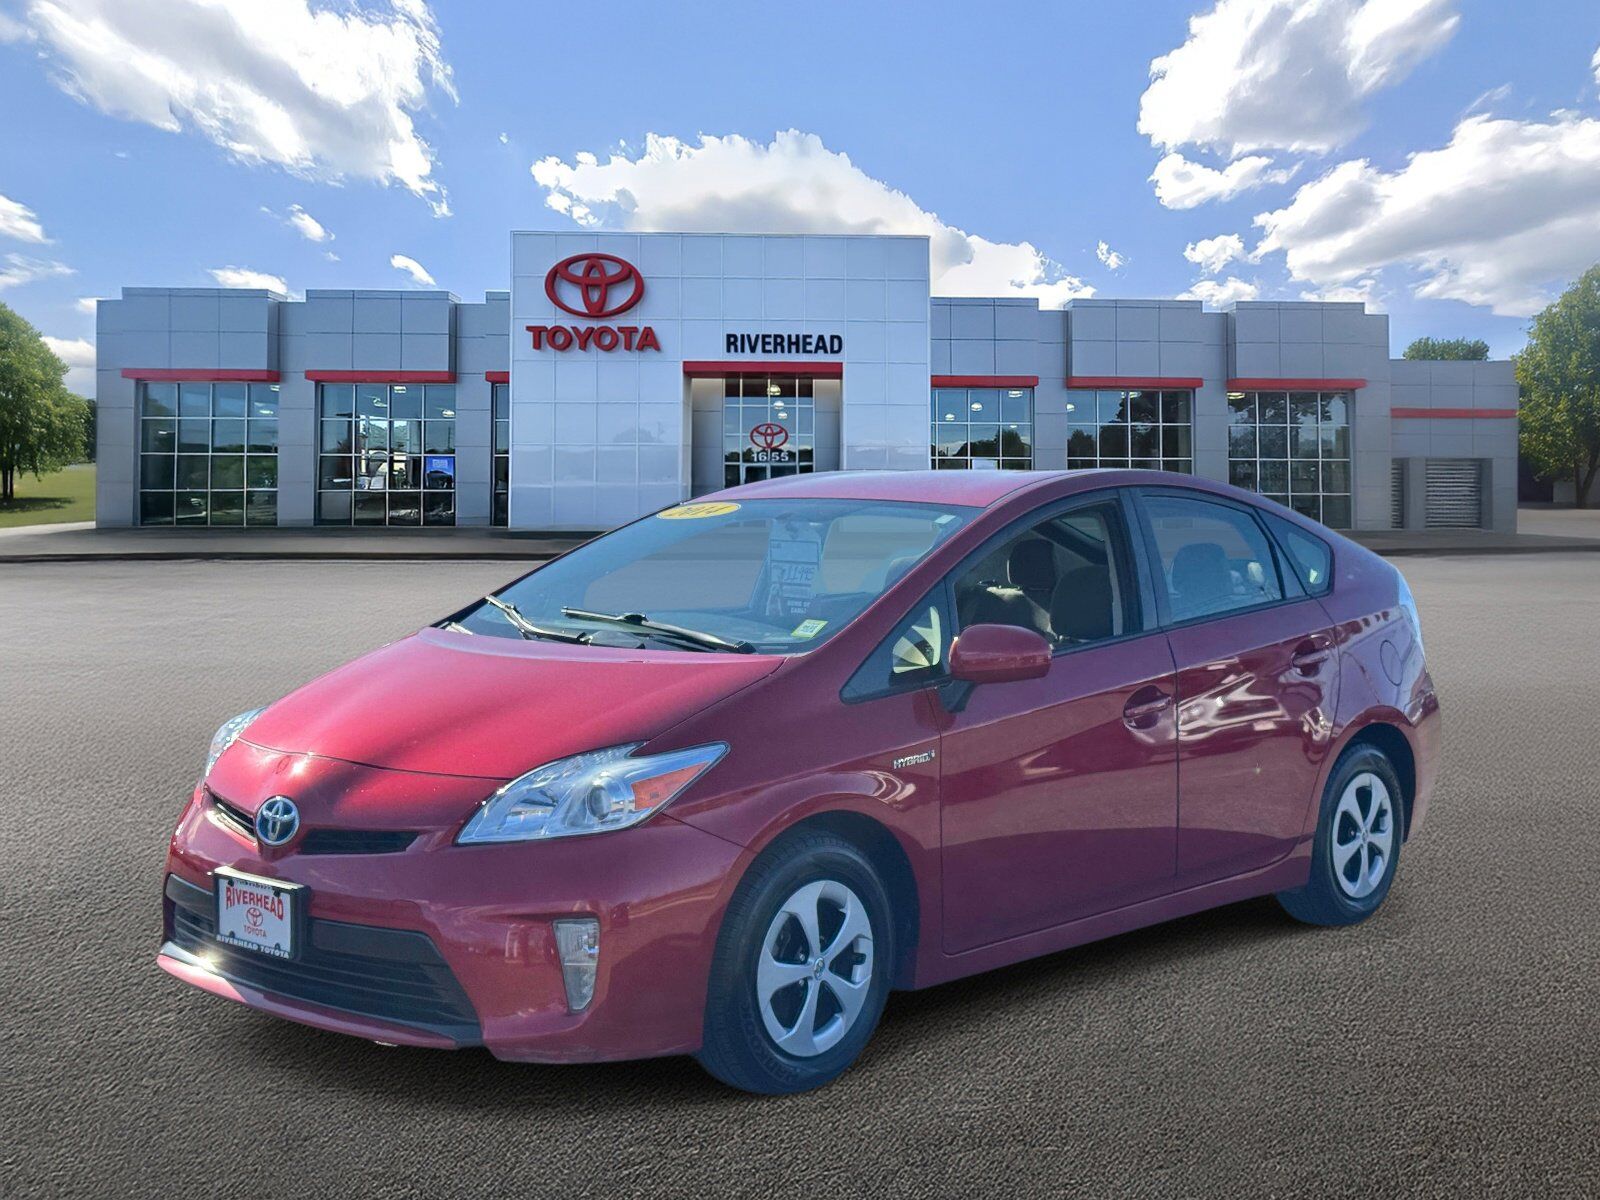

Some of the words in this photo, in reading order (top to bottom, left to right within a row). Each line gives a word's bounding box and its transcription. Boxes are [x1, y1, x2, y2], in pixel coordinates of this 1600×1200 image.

[526, 325, 662, 353] TOYOTA
[726, 333, 843, 355] RIVERHEAD
[752, 451, 789, 462] 1655
[893, 751, 931, 769] HYBRID
[225, 886, 284, 921] RIVERHEAD
[243, 924, 267, 938] TOYOTA
[216, 934, 258, 951] RIVERHEAD
[260, 945, 289, 959] TOYOTA
